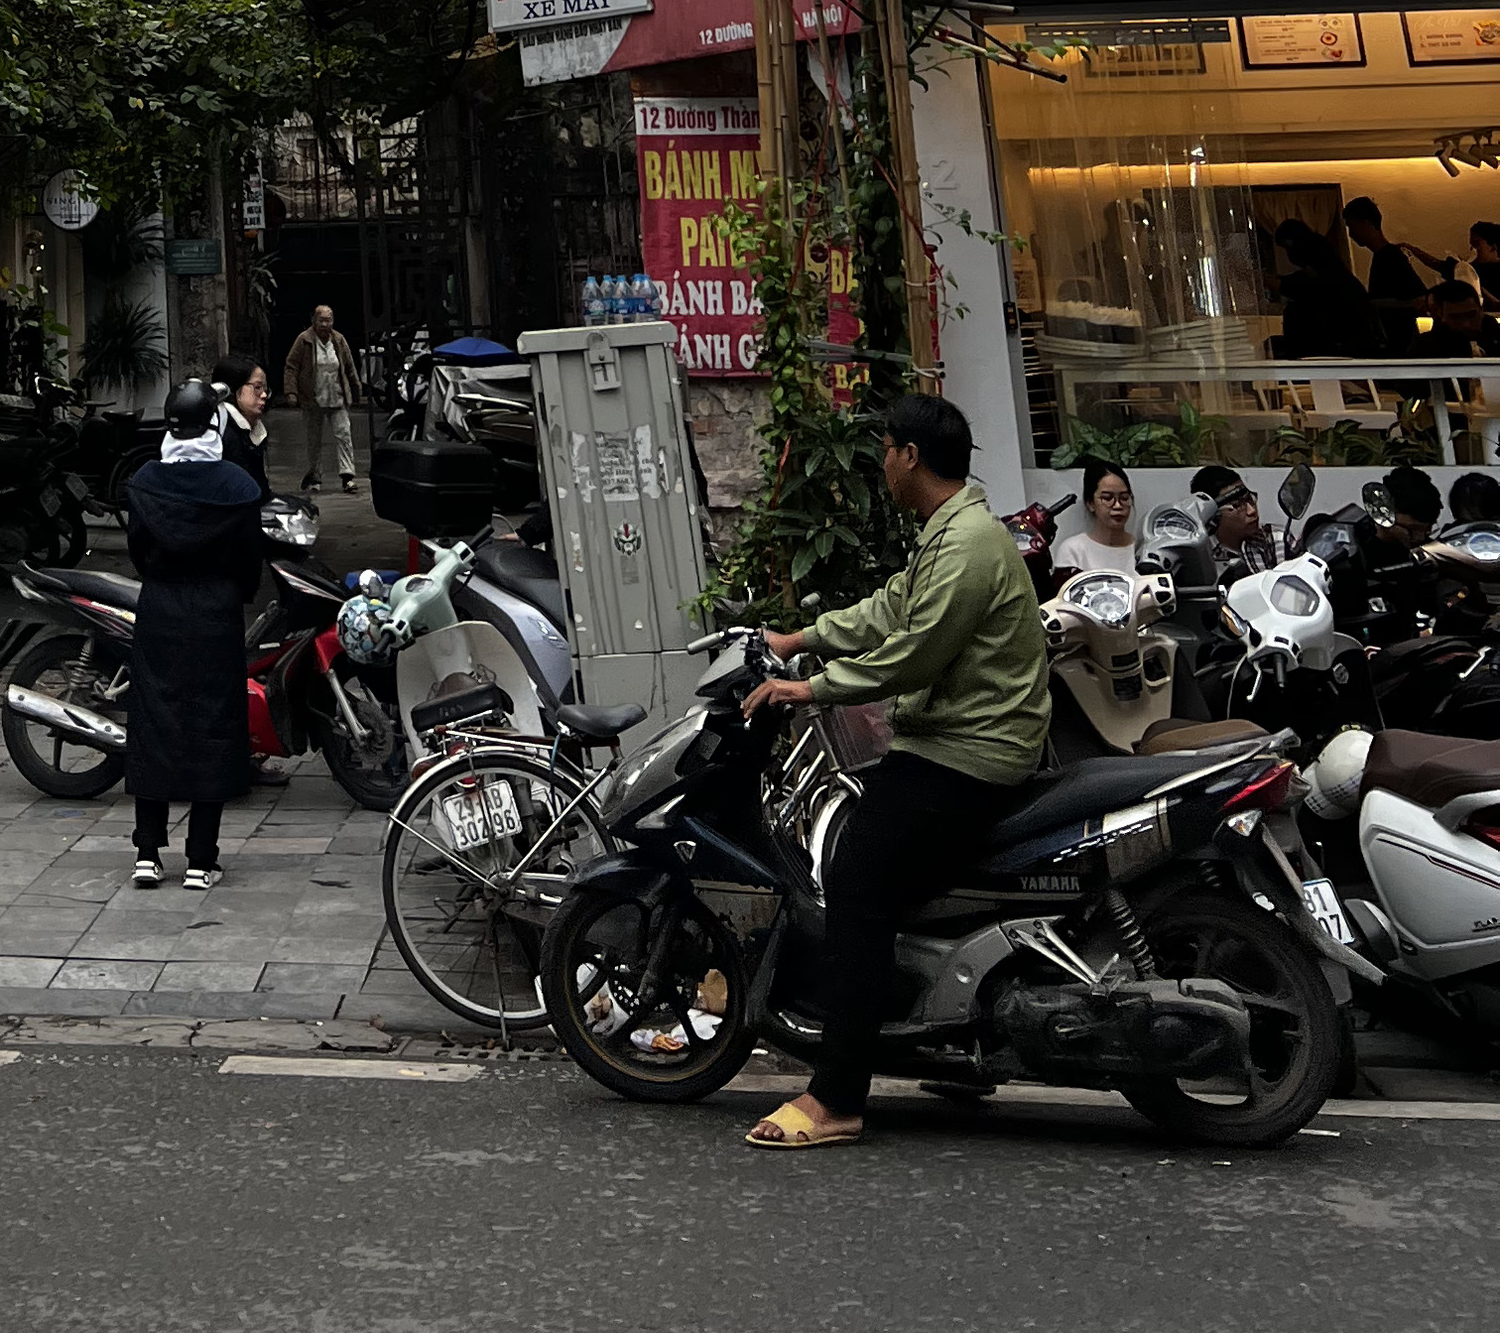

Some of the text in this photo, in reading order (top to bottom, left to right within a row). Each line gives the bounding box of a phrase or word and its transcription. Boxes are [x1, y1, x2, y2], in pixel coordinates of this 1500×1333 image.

[523, 0, 556, 20] XE
[699, 29, 713, 45] 12
[640, 108, 661, 130] 12
[721, 105, 760, 130] Thàn
[644, 140, 722, 200] BÁNH
[1020, 875, 1080, 891] YAMAHA
